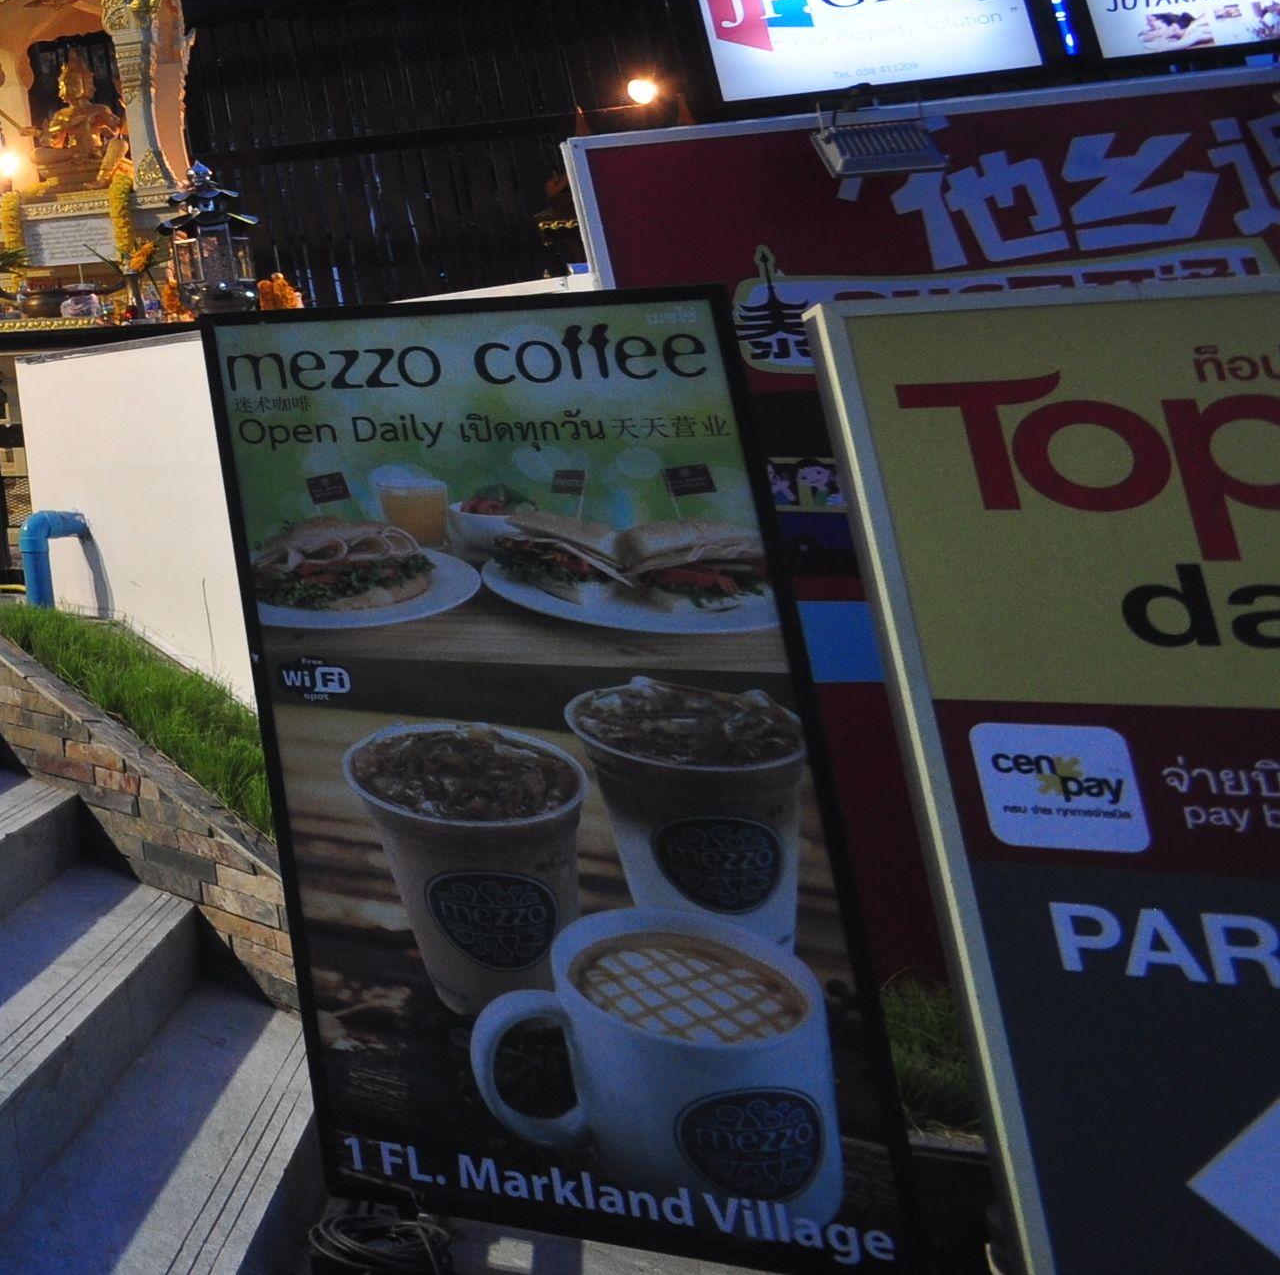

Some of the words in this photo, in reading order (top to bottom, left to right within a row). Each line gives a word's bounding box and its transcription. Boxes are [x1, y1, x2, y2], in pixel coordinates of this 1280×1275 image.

[226, 345, 440, 393] mezzo
[472, 322, 708, 386] coffee
[237, 417, 338, 451] Open
[351, 413, 444, 449] Daily
[458, 408, 606, 453] เปิดทุกวัน
[610, 414, 731, 439] 天天营业
[1183, 805, 1251, 832] pay
[343, 1137, 366, 1172] 1
[380, 1141, 446, 1185] FL.
[458, 1153, 695, 1226] Markland
[696, 1190, 895, 1266] Village
